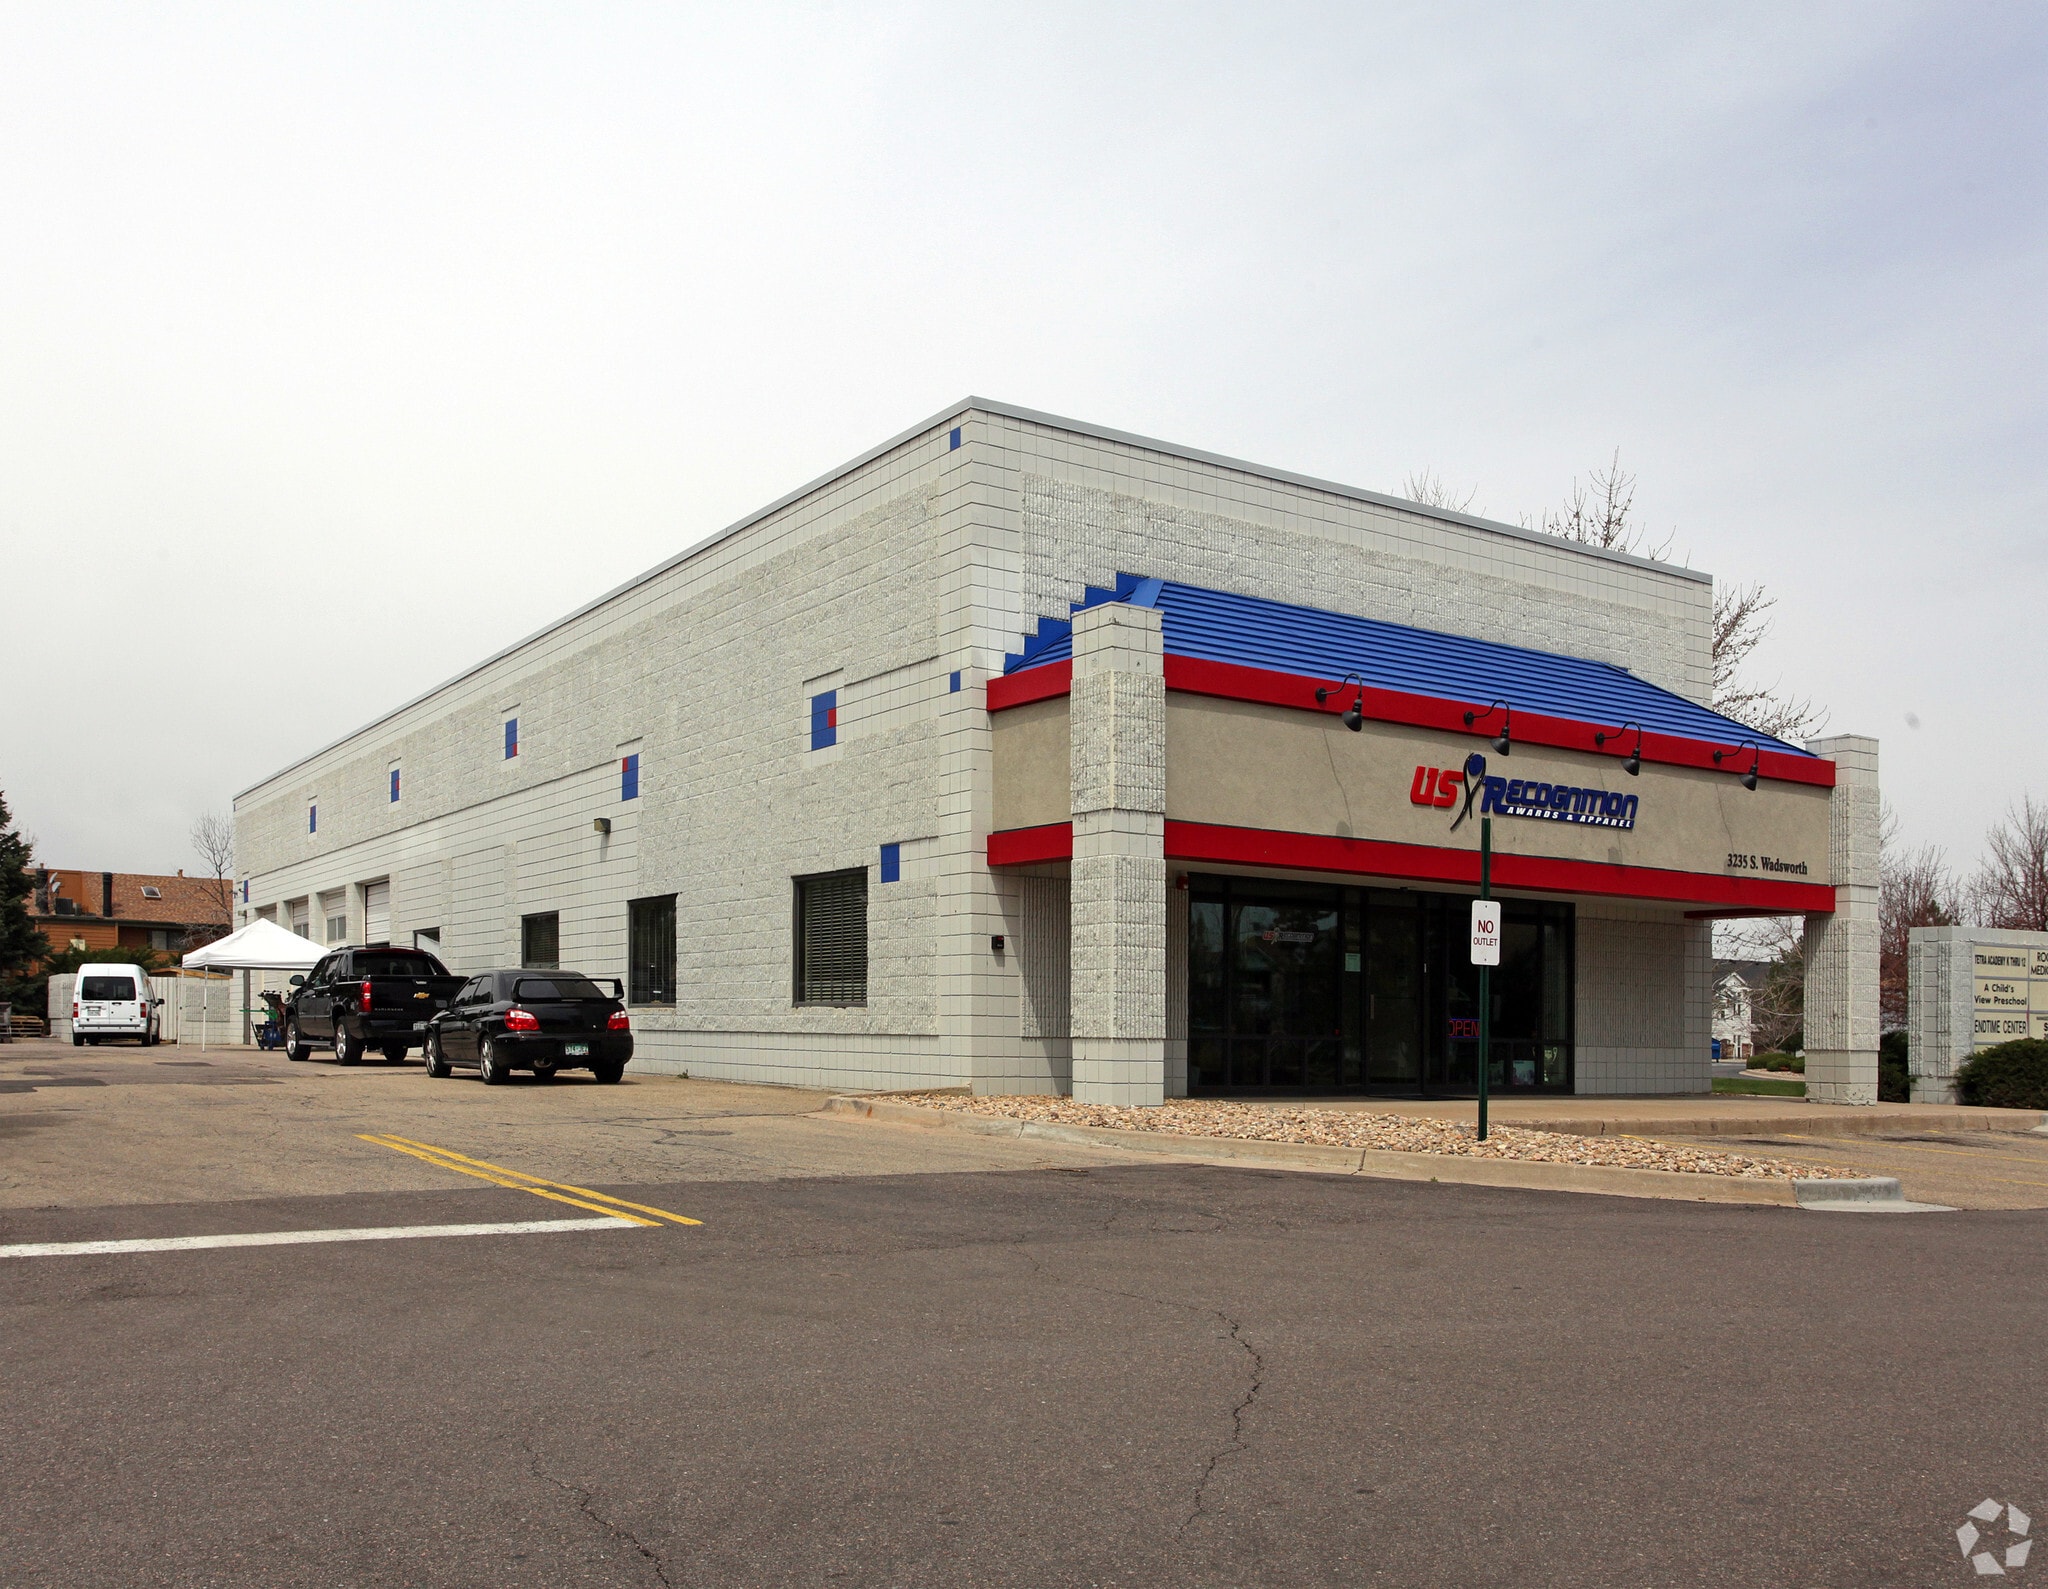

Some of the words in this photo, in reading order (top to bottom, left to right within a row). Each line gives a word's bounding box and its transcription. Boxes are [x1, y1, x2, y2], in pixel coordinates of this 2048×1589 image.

[1410, 765, 1464, 807] US
[1481, 775, 1639, 819] RECOGNITION
[1507, 806, 1558, 819] AWARDS
[1579, 815, 1632, 829] APPAREL
[1727, 853, 1748, 869] 3235
[1750, 855, 1758, 870] S.
[1761, 856, 1808, 875] Wadsworth
[1478, 920, 1494, 934] NO
[1473, 937, 1498, 946] OUTLET
[1984, 984, 1989, 992] A
[1992, 984, 2014, 993] Child's
[1974, 995, 1991, 1004] View
[1994, 996, 2027, 1005] Preschool
[1975, 1019, 2000, 1034] ENDTIME
[2002, 1020, 2027, 1034] CENTER
